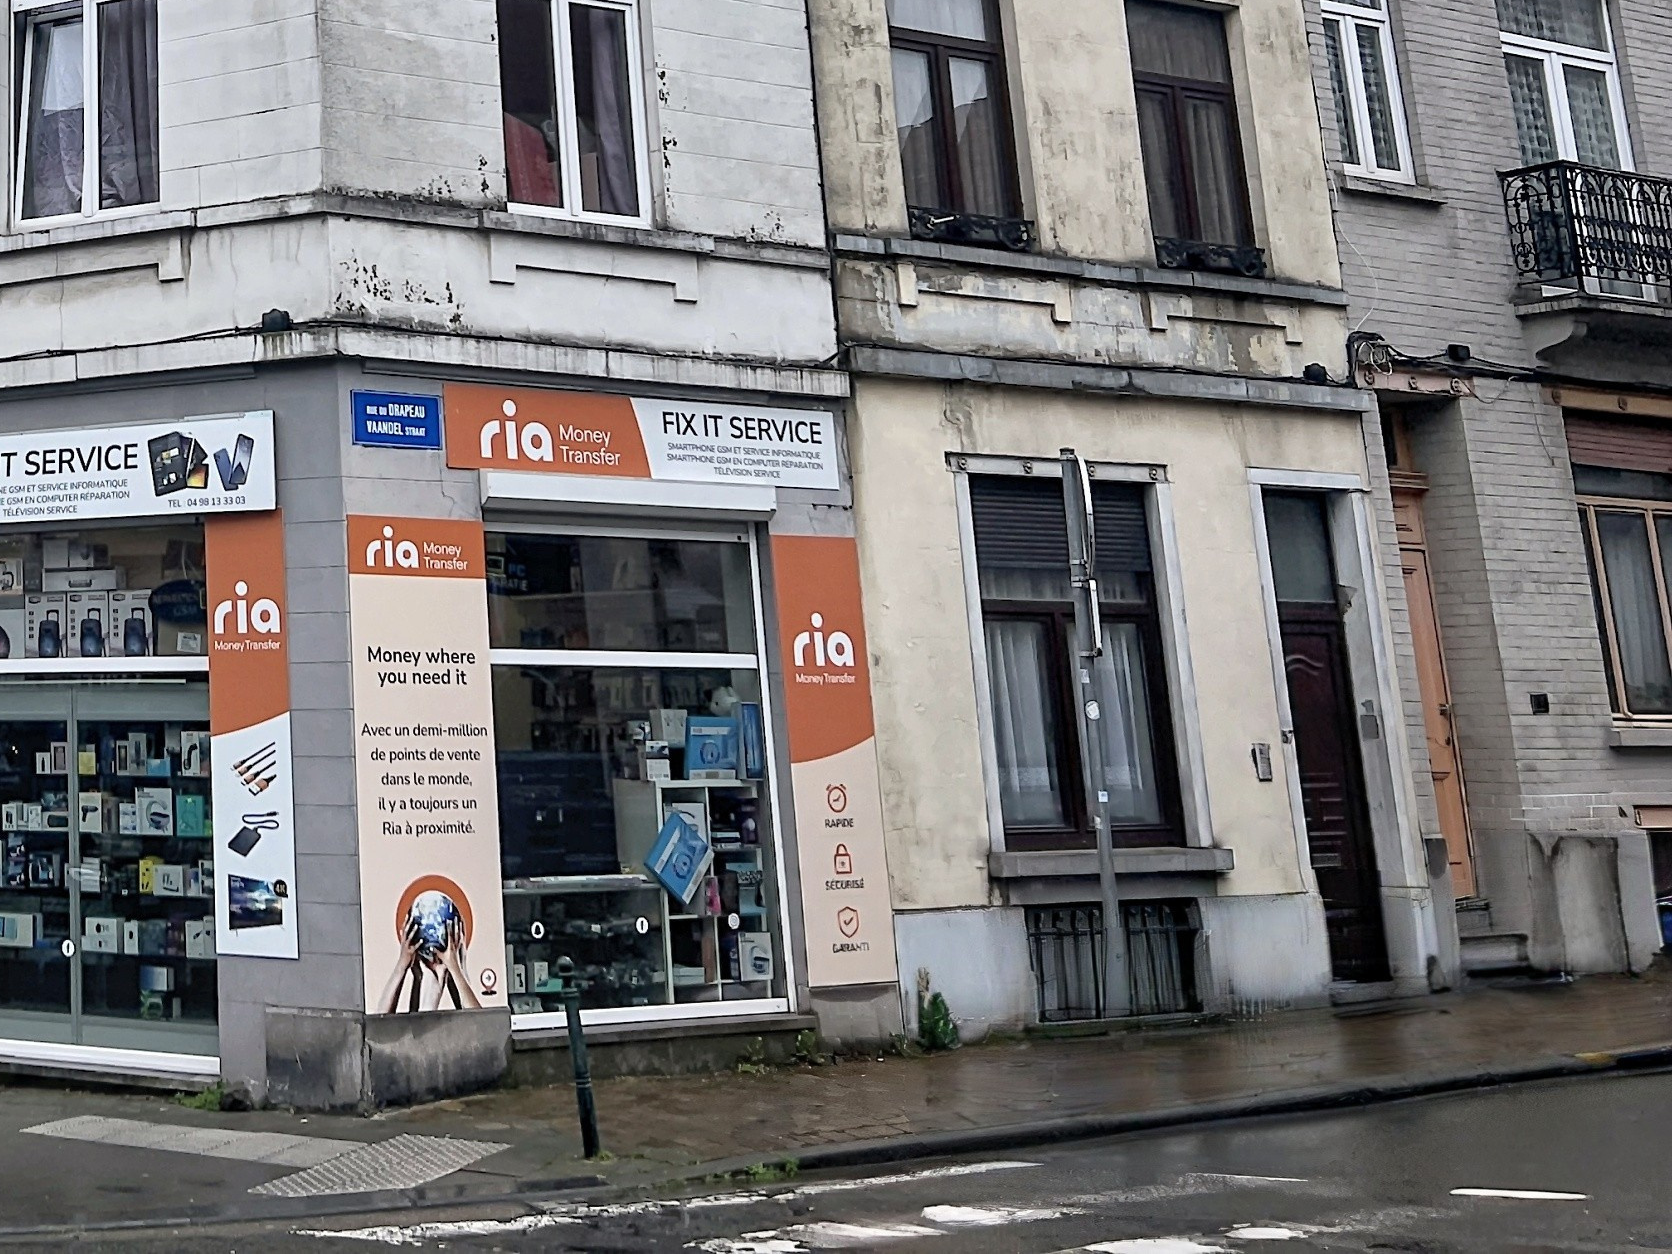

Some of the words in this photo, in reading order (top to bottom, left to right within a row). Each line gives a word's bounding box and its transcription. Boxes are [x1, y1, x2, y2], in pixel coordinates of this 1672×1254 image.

[388, 403, 425, 419] DRAPEAU
[366, 420, 404, 436] VAANDEL
[404, 426, 426, 436] STRAAT
[480, 399, 554, 462] ria
[559, 424, 611, 447] Money
[662, 411, 698, 436] FIX
[703, 415, 723, 437] IT
[729, 416, 822, 444] SERVICE
[559, 446, 621, 466] Transfer
[667, 442, 715, 453] SMARTPHONE
[716, 445, 732, 454] GSM
[733, 447, 742, 455] ET
[743, 447, 771, 457] SERVICE
[771, 449, 821, 459] INFORMATIQUE
[24, 443, 139, 476] SERVICE
[666, 453, 715, 463] SMARTPHONE
[716, 456, 732, 465] GSM
[733, 457, 742, 465] EN
[743, 457, 780, 467] COMPUTER
[753, 469, 781, 478] SERVICE
[8, 485, 25, 494] GSM
[27, 484, 36, 493] ET
[37, 482, 68, 492] SERVICE
[70, 479, 128, 490] INFORMATIQUE
[6, 497, 23, 506] GSM
[25, 496, 35, 504] EN
[36, 494, 79, 504] COMPUTER
[168, 499, 181, 507] TEL
[187, 498, 197, 506] 04
[199, 498, 209, 506] 98
[212, 497, 221, 506] 13
[223, 496, 233, 505] 33
[235, 496, 246, 504] 03
[3, 506, 45, 517] TÉLÉVISION
[46, 505, 77, 514] SERVICE
[366, 525, 419, 568] ria
[423, 542, 461, 557] Money
[423, 556, 468, 570] Transfer
[214, 580, 281, 634] ria
[214, 640, 244, 652] Money
[245, 639, 281, 650] Transfer
[793, 612, 855, 666] ria
[367, 645, 421, 667] Money
[426, 648, 475, 664] where
[377, 671, 407, 687] you
[412, 669, 450, 685] need
[456, 669, 467, 685] it
[795, 672, 823, 685] Money
[823, 672, 856, 684] Transfer
[361, 723, 392, 736] Avec
[394, 726, 410, 736] un
[413, 723, 488, 737] demi-million
[370, 747, 386, 761] de
[389, 747, 426, 764] points
[429, 747, 445, 761] de
[447, 749, 481, 761] vente
[381, 772, 410, 785] dans
[413, 772, 425, 785] le
[428, 772, 473, 787] monde,
[378, 797, 386, 810] il
[388, 799, 396, 813] y
[399, 799, 407, 810] a
[410, 796, 459, 813] toujours
[462, 799, 477, 809] un
[382, 821, 402, 835] Ria
[405, 820, 413, 835] à
[415, 820, 476, 837] proximité.
[824, 818, 854, 828] RAPIDE
[832, 942, 870, 953] GARANTI
